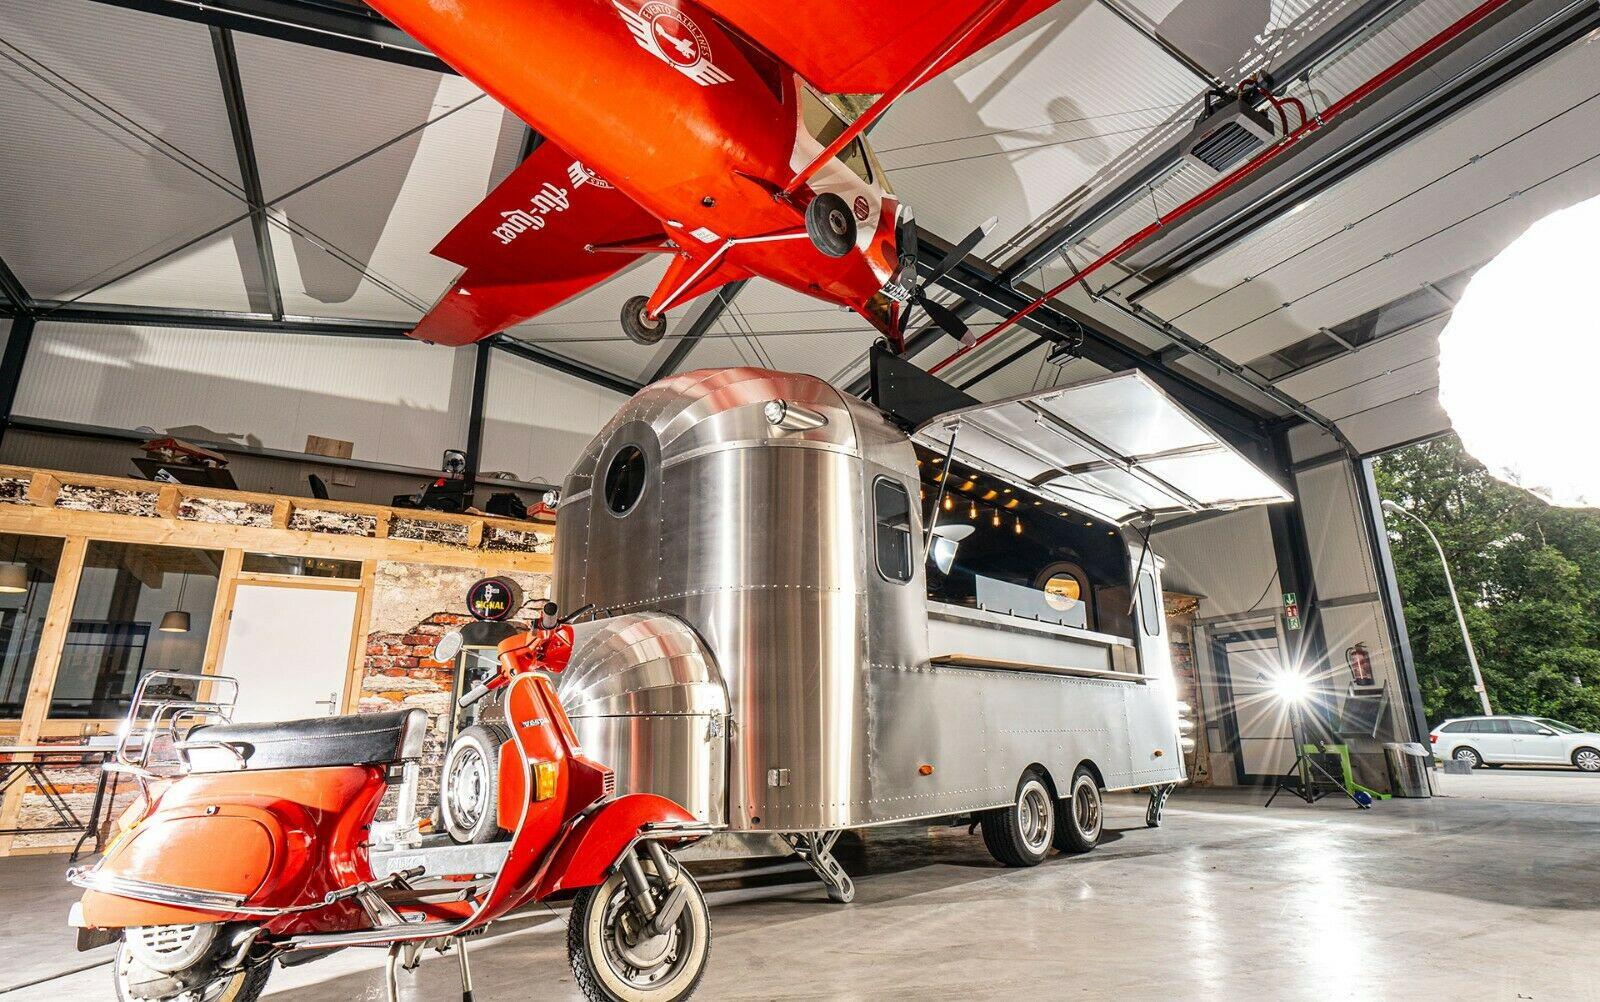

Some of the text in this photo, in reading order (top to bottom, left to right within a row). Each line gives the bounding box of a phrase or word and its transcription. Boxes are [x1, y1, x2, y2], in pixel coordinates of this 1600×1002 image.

[642, 4, 710, 57] EVENTO AIRLINES
[475, 600, 505, 610] SIGNAL
